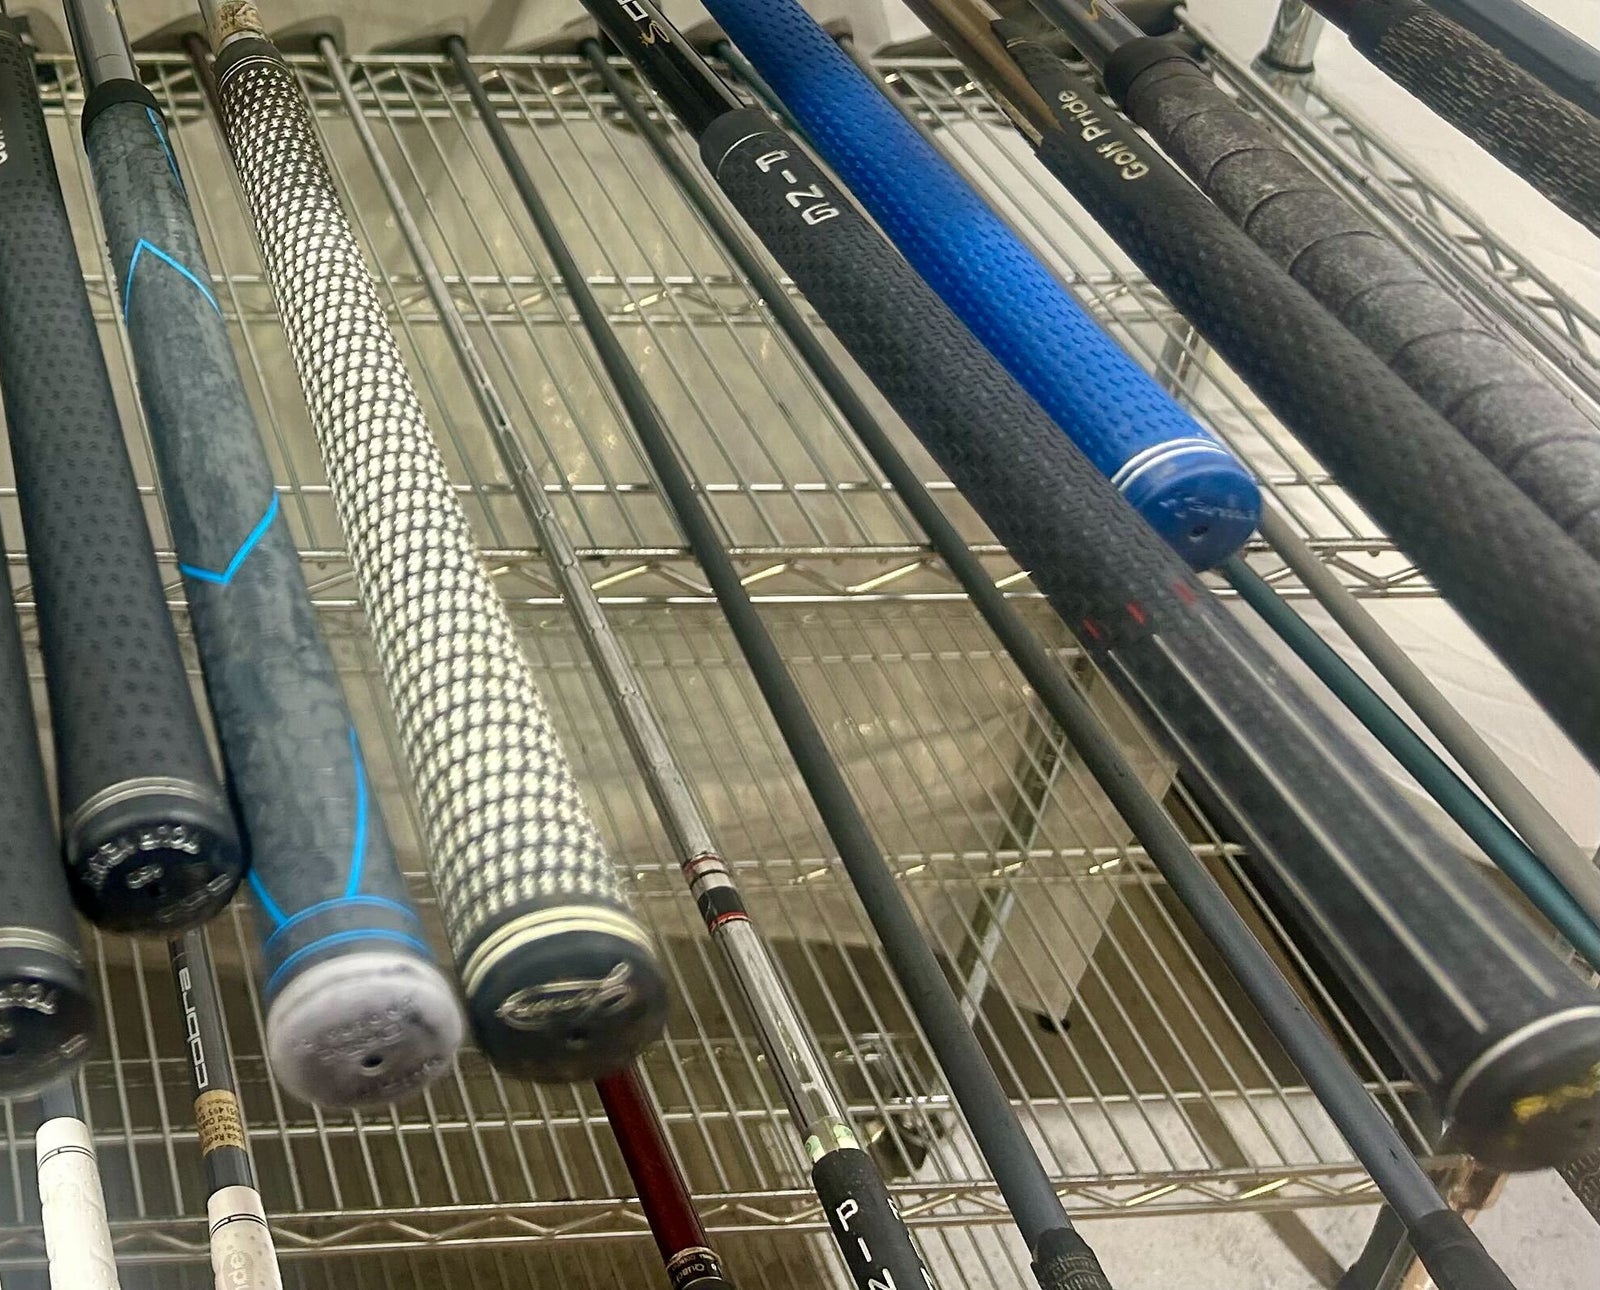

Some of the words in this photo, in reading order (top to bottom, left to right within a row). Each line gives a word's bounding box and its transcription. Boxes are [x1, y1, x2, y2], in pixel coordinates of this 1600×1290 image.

[1058, 89, 1112, 142] Pride
[1095, 140, 1150, 180] Golf
[178, 966, 209, 1089] cobra
